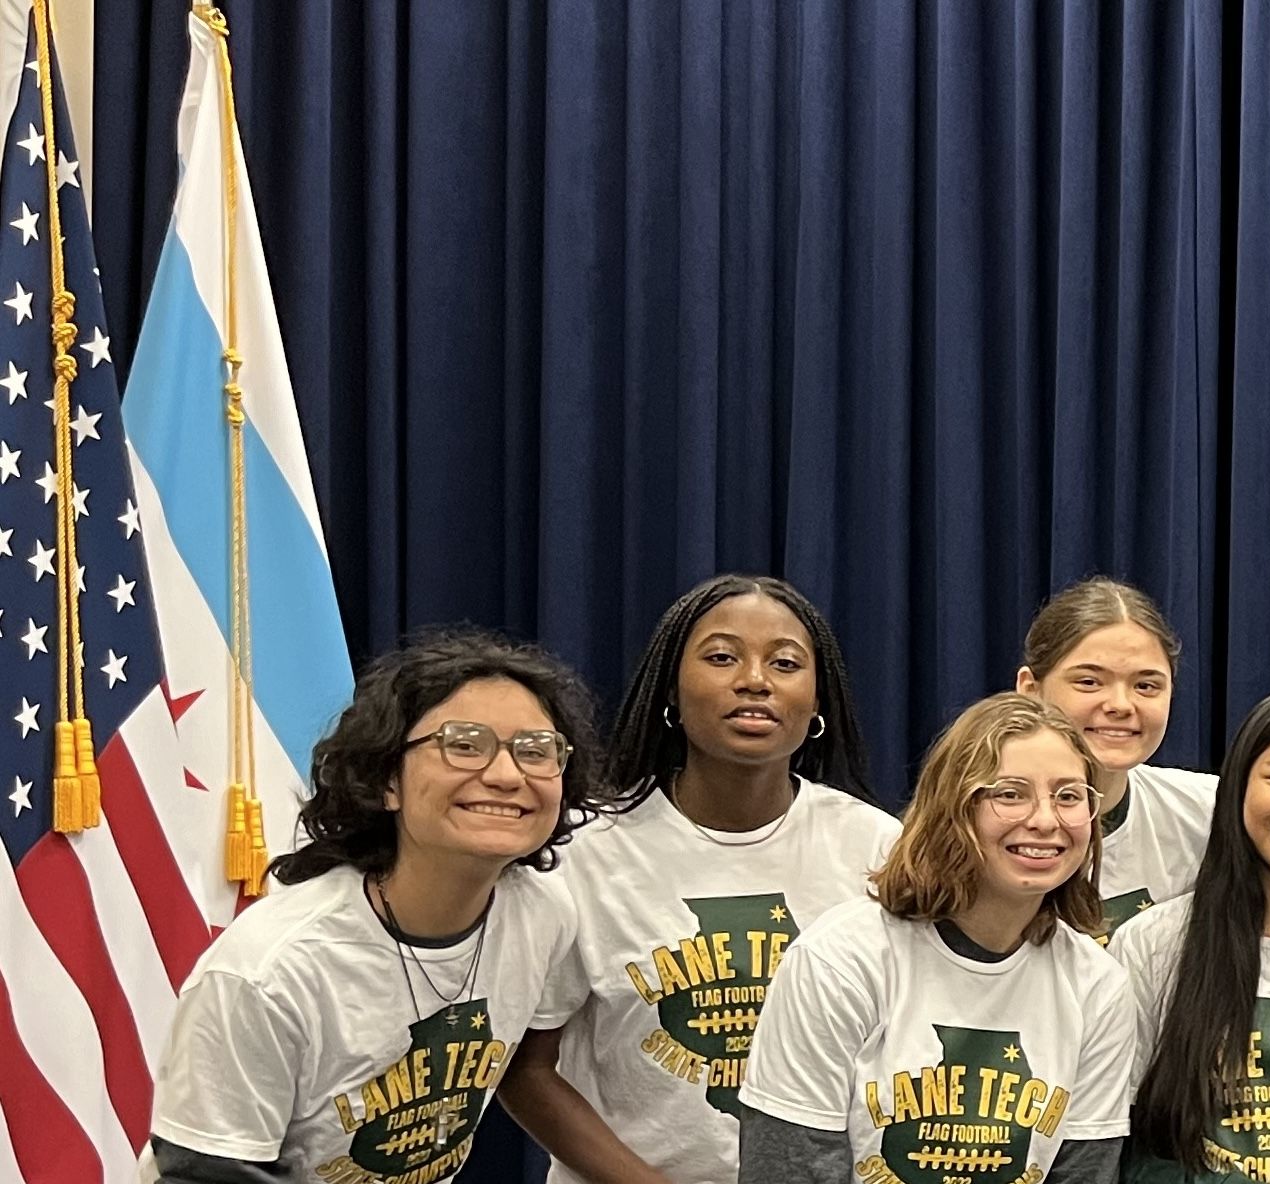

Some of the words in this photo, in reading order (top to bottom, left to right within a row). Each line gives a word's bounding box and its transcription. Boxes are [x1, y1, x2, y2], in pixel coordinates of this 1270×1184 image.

[625, 932, 736, 1006] LANE
[746, 931, 790, 979] TE
[691, 987, 722, 1008] FLAG
[724, 985, 767, 1004] FOOTB
[640, 1028, 707, 1085] STATE
[725, 1036, 752, 1053] 202
[334, 1048, 431, 1135] LANE
[443, 1039, 518, 1091] TEC
[866, 1065, 966, 1129] LANE
[977, 1066, 1071, 1138] TECH
[386, 1108, 414, 1132] FLAG
[918, 1122, 949, 1142] FLAG
[951, 1124, 1011, 1144] FOOTBALL
